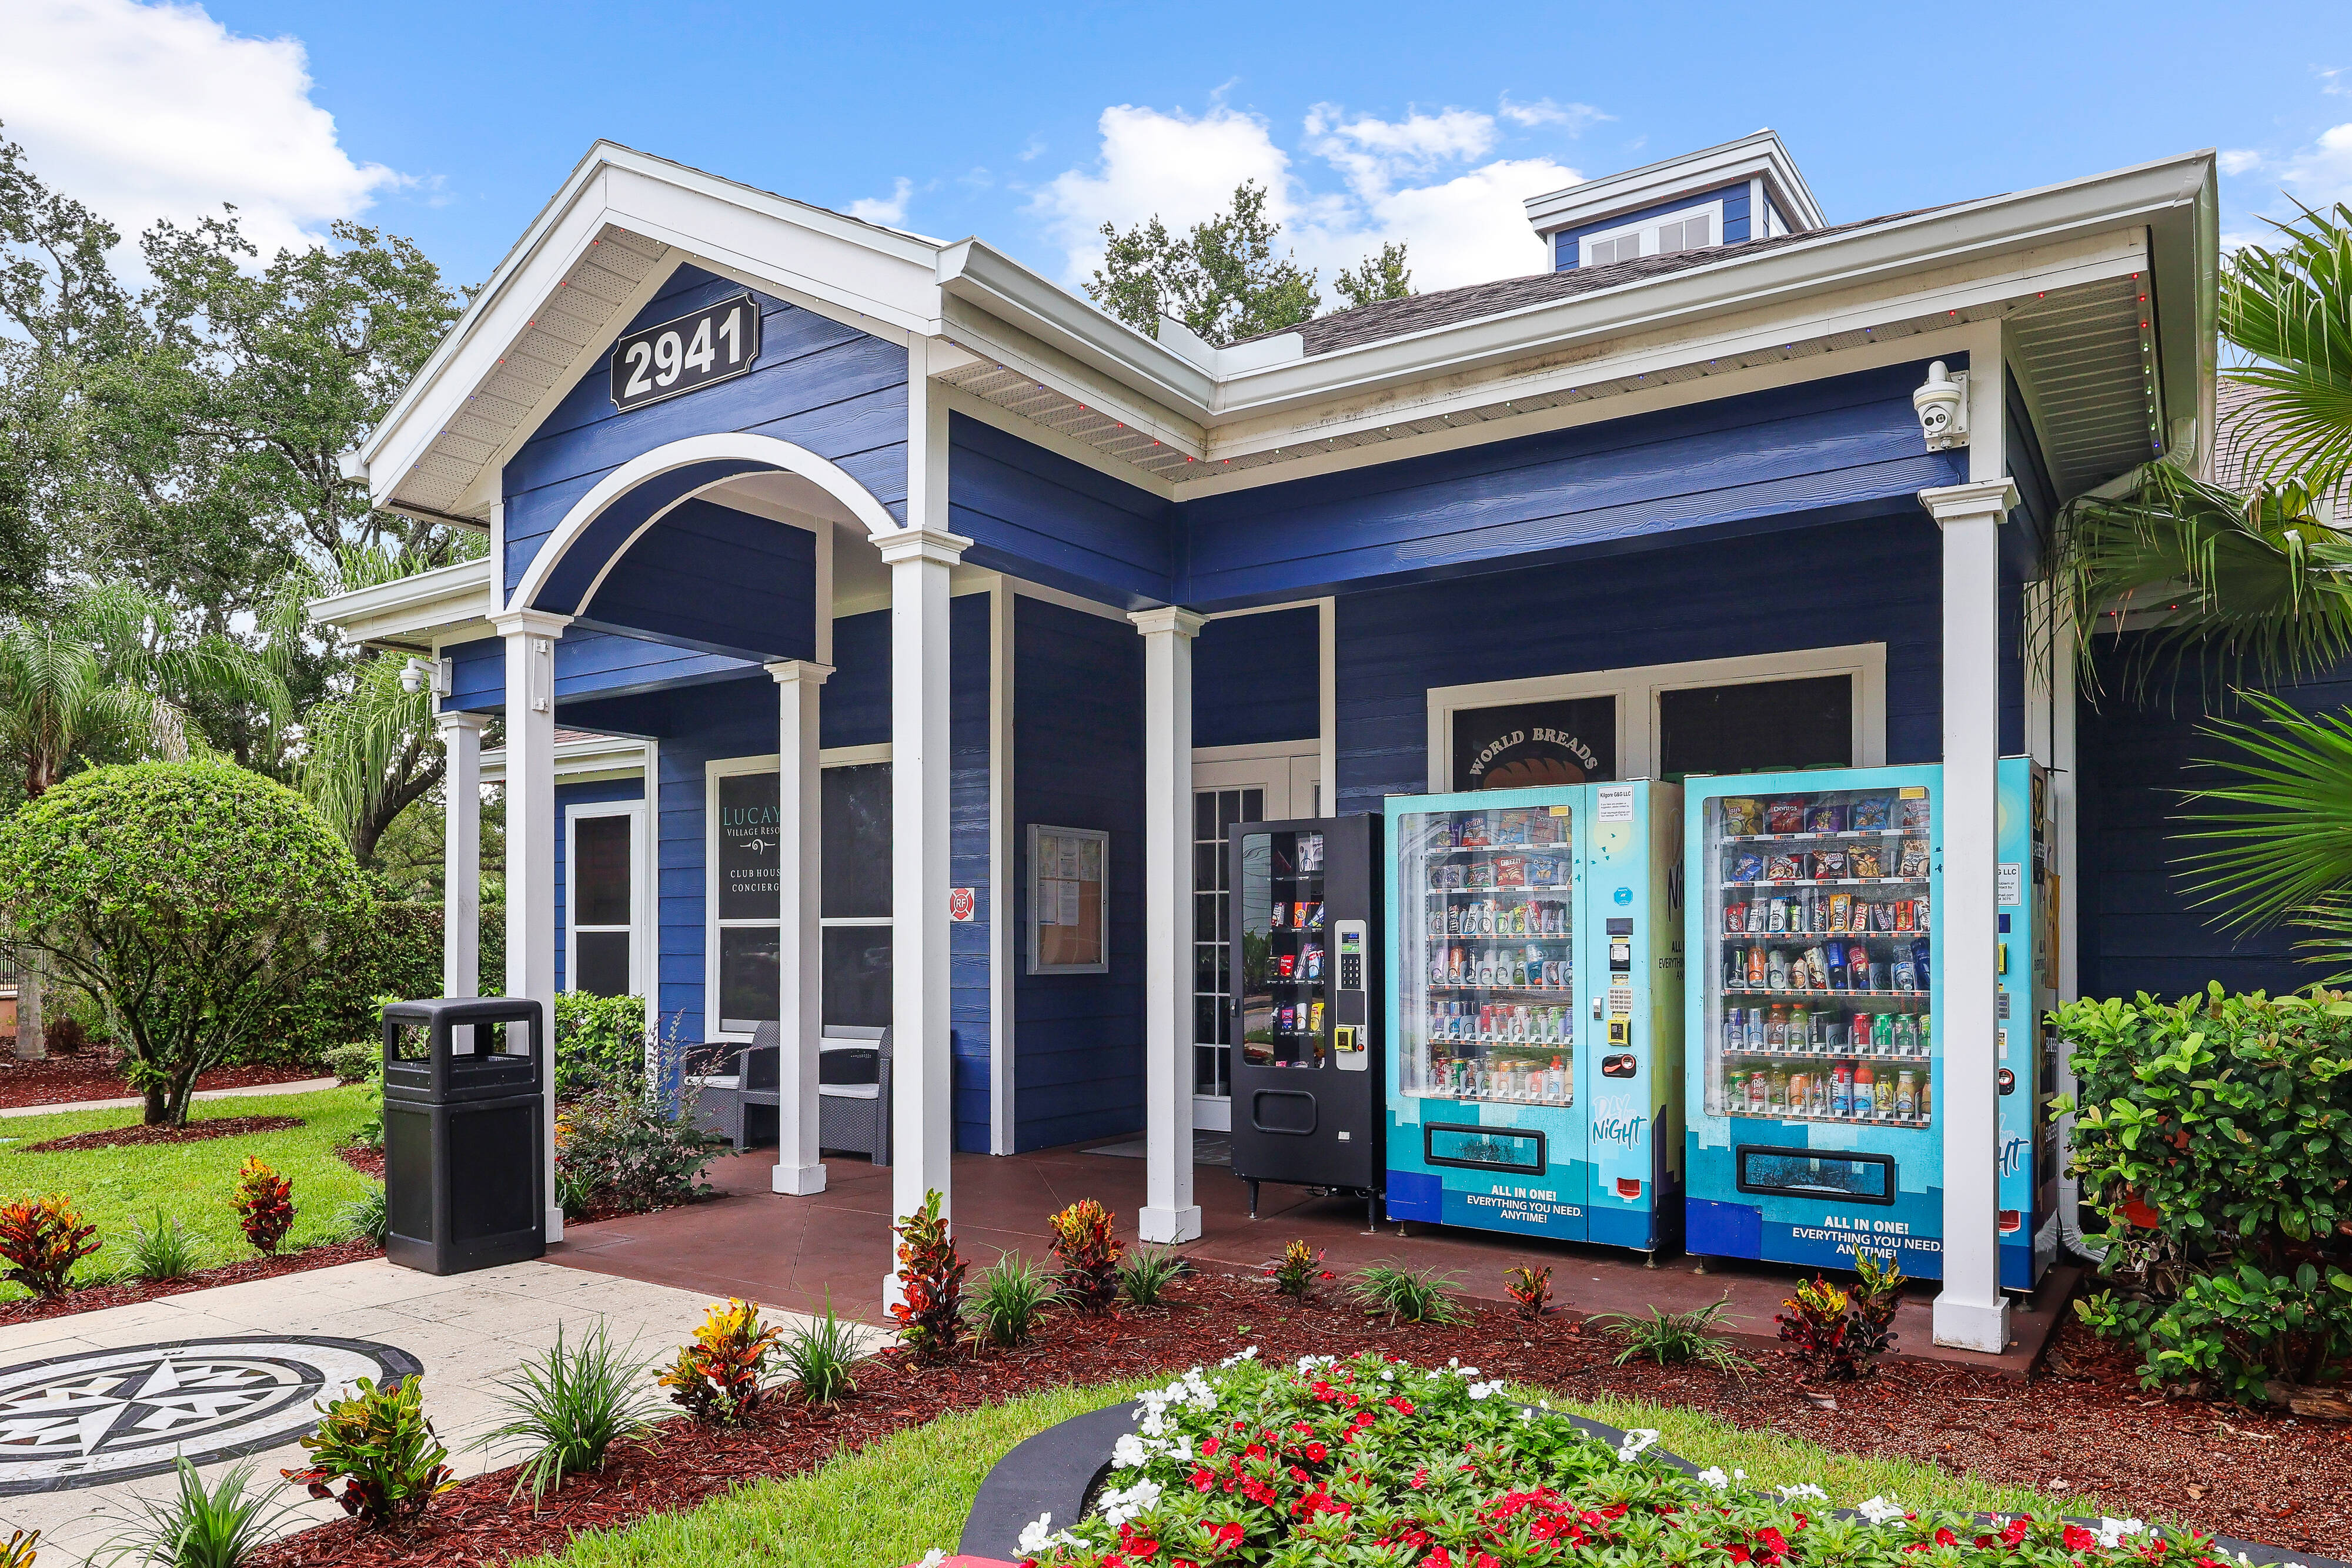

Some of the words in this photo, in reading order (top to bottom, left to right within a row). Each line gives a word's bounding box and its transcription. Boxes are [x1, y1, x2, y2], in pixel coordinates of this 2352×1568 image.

[624, 306, 740, 399] 2941
[1469, 730, 1525, 775] WORLD
[1532, 728, 1598, 770] BREADS
[723, 806, 781, 825] LUCAY
[1728, 806, 1742, 815] Lay's
[727, 828, 758, 837] VILLAGE
[761, 827, 780, 835] RESO
[730, 869, 754, 878] CLUB
[757, 868, 781, 877] HOUS
[732, 883, 780, 892] CONCIERG
[956, 898, 966, 908] RF
[1672, 940, 1682, 952] ALL
[1659, 957, 1685, 969] EVERYTHIN
[1593, 1094, 1631, 1121] DAY
[1491, 1185, 1512, 1197] ALL
[1514, 1187, 1527, 1198] IN
[1529, 1189, 1557, 1202] ONE!
[1467, 1195, 1528, 1211] EVERYTHING
[1529, 1201, 1551, 1213] YOU
[1552, 1204, 1583, 1218] NEED.
[1500, 1209, 1548, 1223] ANYTIME!
[1824, 1215, 1850, 1229] ALL
[1854, 1218, 1870, 1231] IN
[1873, 1220, 1910, 1235] ONE!
[1792, 1227, 1870, 1245] EVERYTHING
[1873, 1235, 1901, 1248] YOU
[1904, 1238, 1943, 1252] NEED.
[1836, 1243, 1897, 1259] ANTIME!
